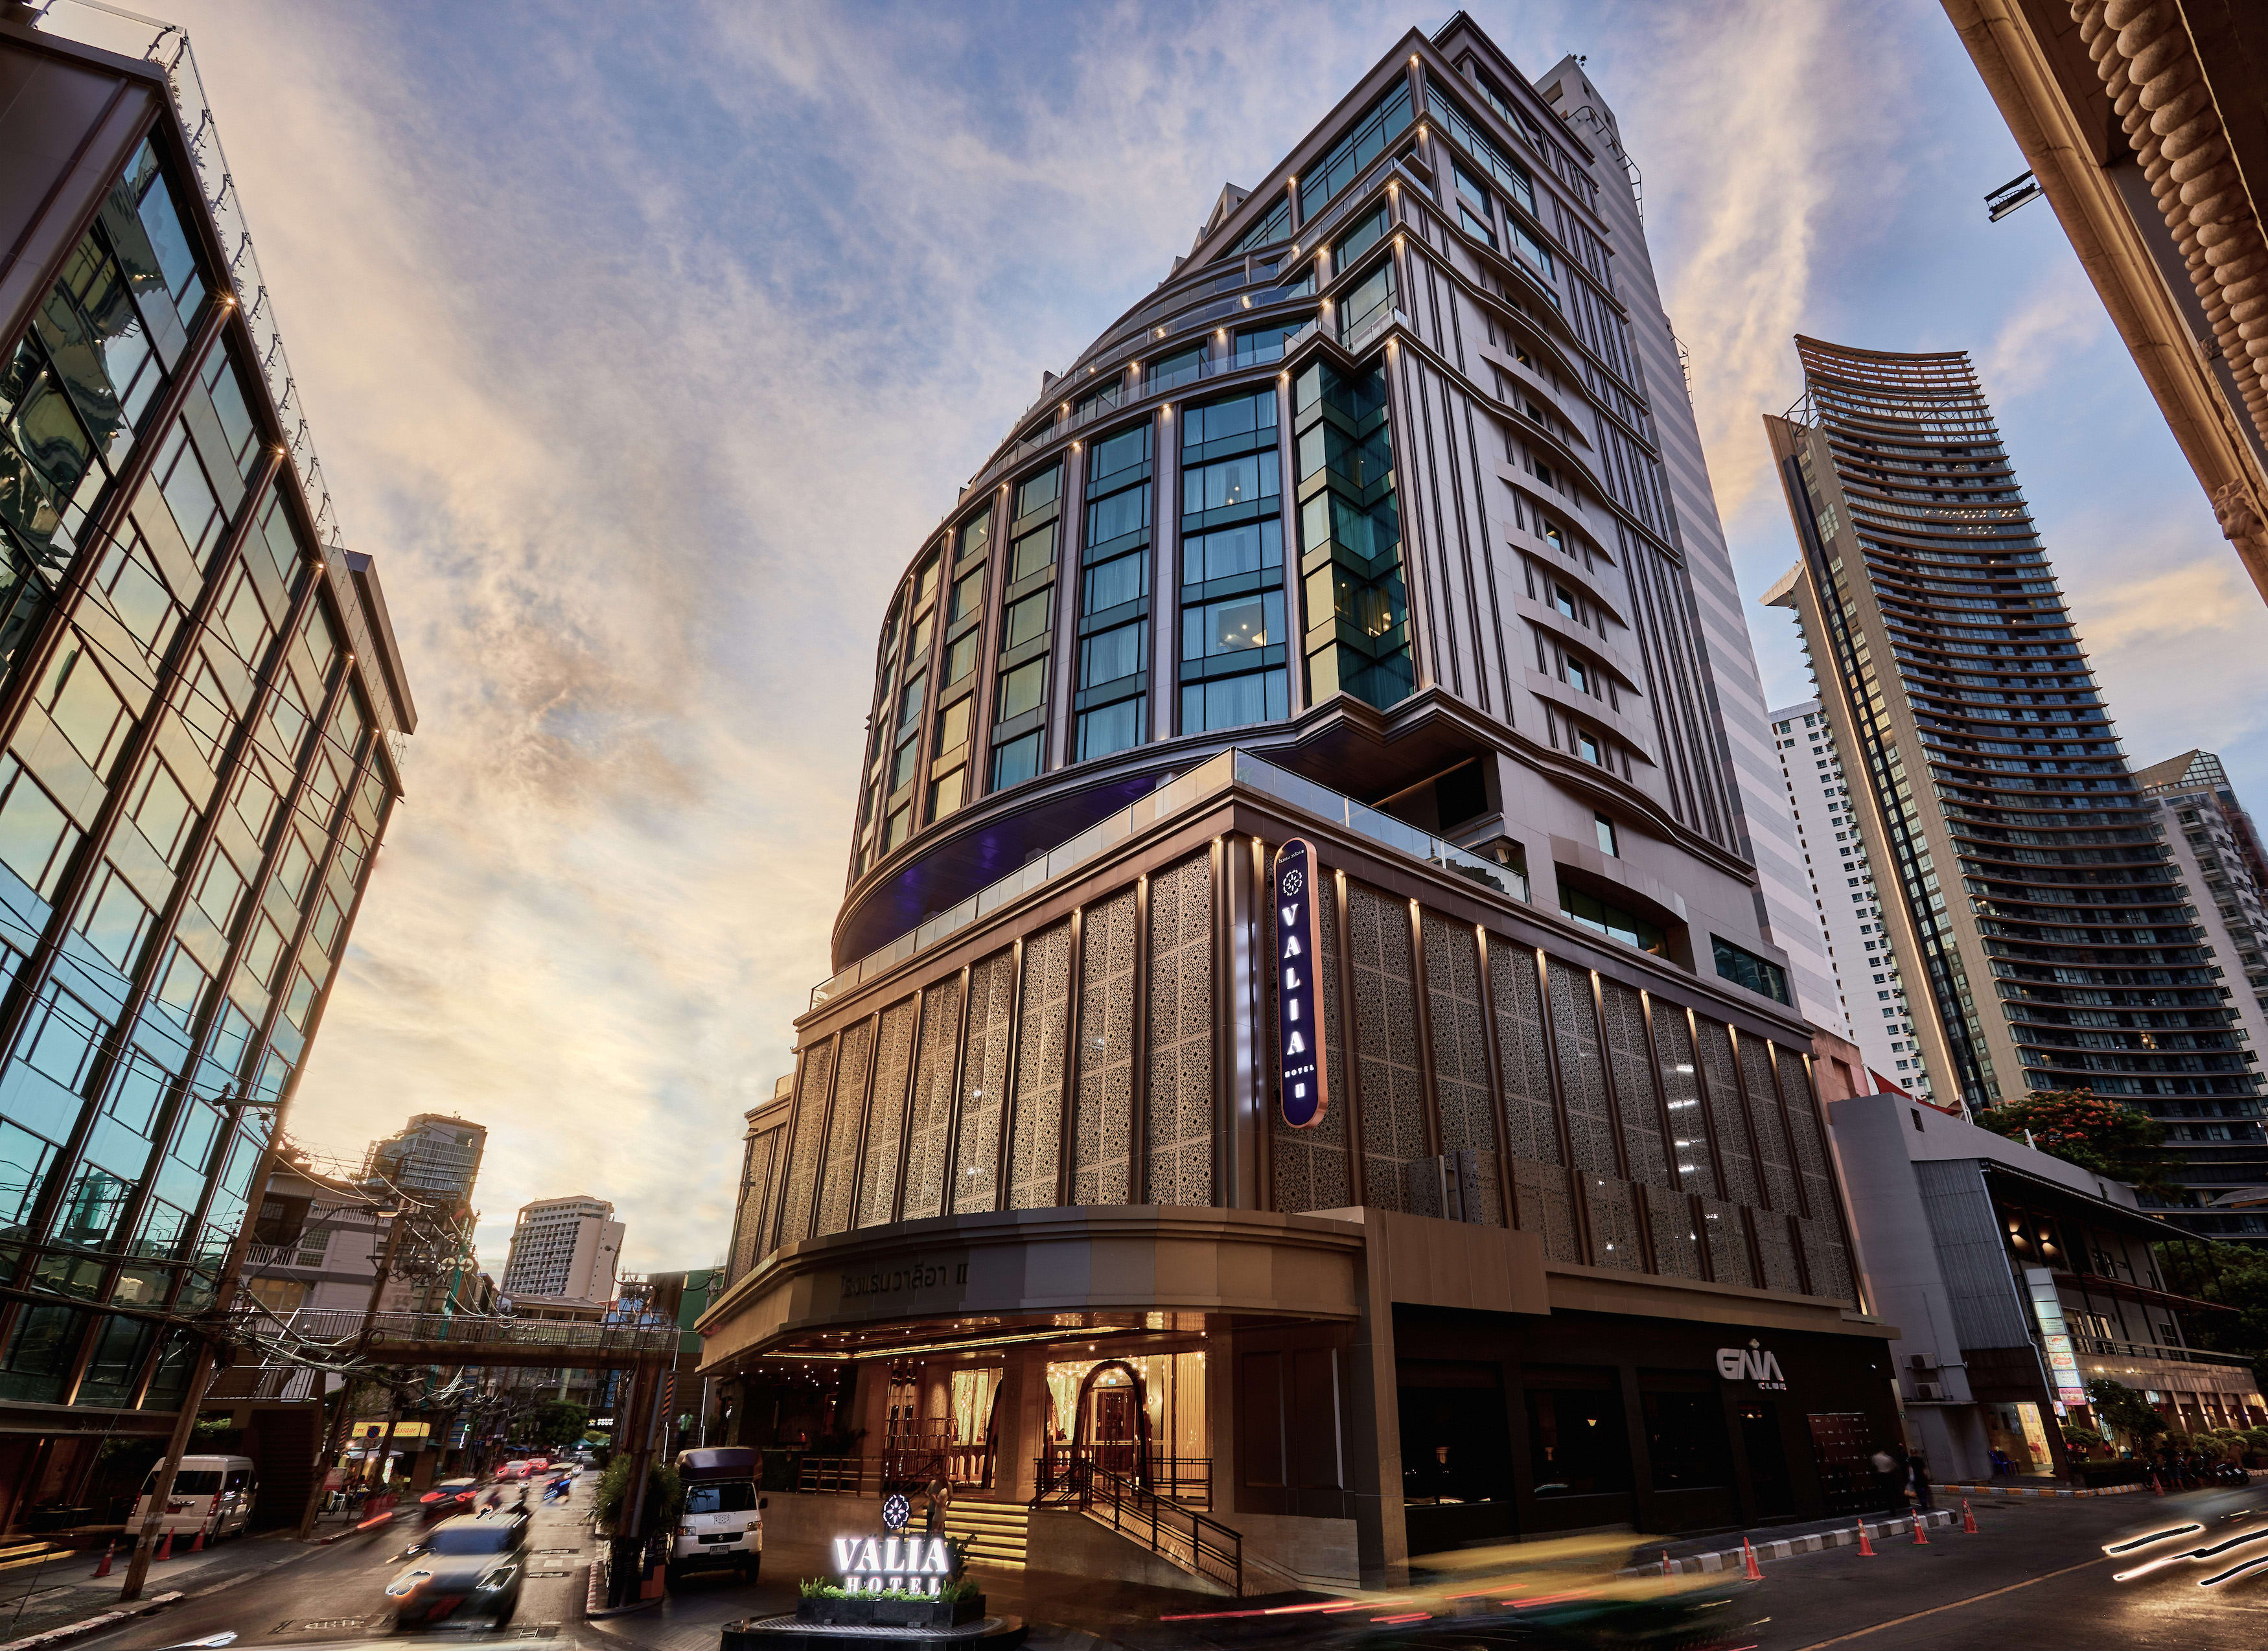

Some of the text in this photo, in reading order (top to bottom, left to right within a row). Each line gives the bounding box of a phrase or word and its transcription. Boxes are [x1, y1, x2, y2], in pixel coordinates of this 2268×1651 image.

[1282, 904, 1304, 1056] VALIA
[1284, 1064, 1314, 1078] HOTEL
[1758, 1382, 1787, 1391] CLUB
[395, 1427, 417, 1436] assage
[835, 1538, 949, 1572] VALIA
[845, 1576, 941, 1595] HOTEL
